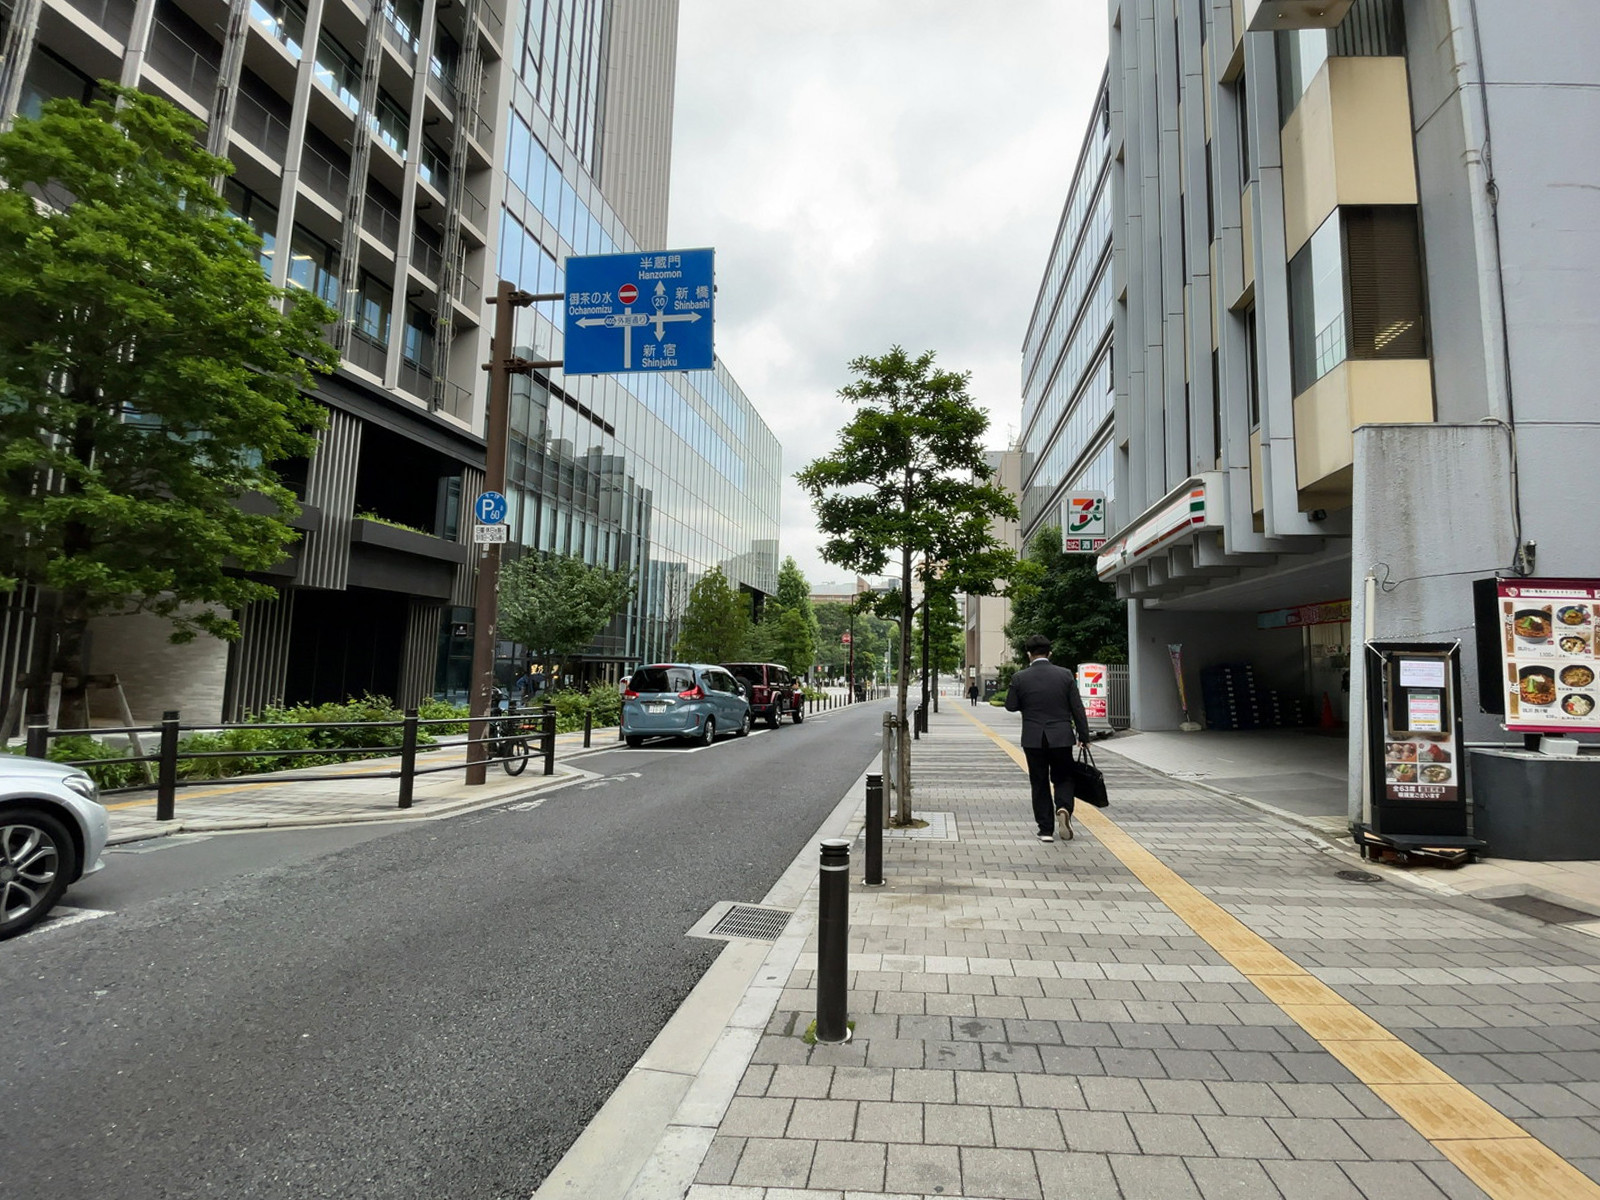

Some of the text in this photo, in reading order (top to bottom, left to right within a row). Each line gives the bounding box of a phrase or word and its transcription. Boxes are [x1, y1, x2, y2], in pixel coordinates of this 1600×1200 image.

[640, 255, 681, 269] 半蔵門
[638, 270, 682, 280] Hanzomon
[569, 291, 612, 305] 御茶の水
[675, 285, 709, 299] 新橋
[654, 297, 667, 307] 20
[673, 300, 711, 311] Shinbashi
[568, 305, 613, 316] Ochanomizu
[642, 343, 676, 357] 新宿
[641, 357, 678, 369] Shinjuku
[482, 499, 495, 519] P
[490, 510, 500, 519] 60
[1084, 672, 1103, 695] 7
